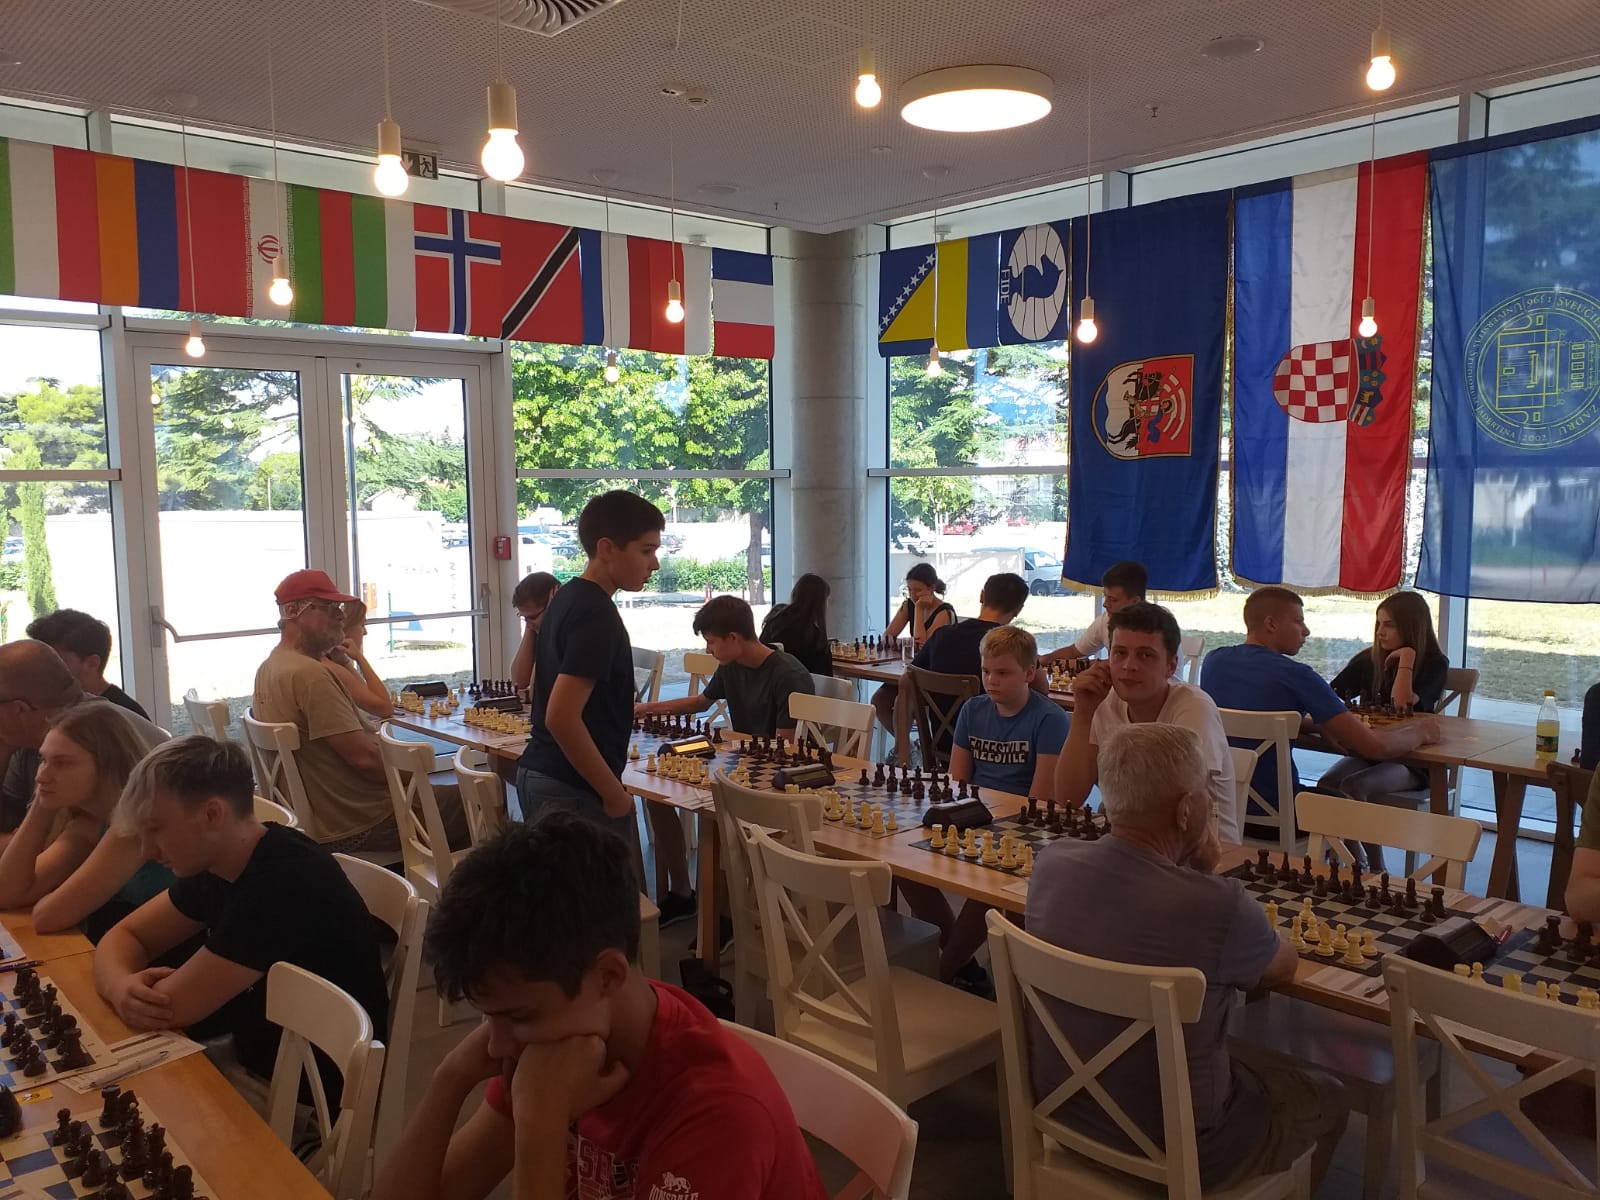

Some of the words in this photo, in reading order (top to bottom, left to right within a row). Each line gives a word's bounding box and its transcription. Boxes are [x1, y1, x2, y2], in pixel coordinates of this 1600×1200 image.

[1000, 268, 1011, 304] FIDE
[1557, 296, 1600, 331] SVEUČIL
[1559, 404, 1598, 435] ZADRU
[968, 735, 1030, 765] FREESTYLE
